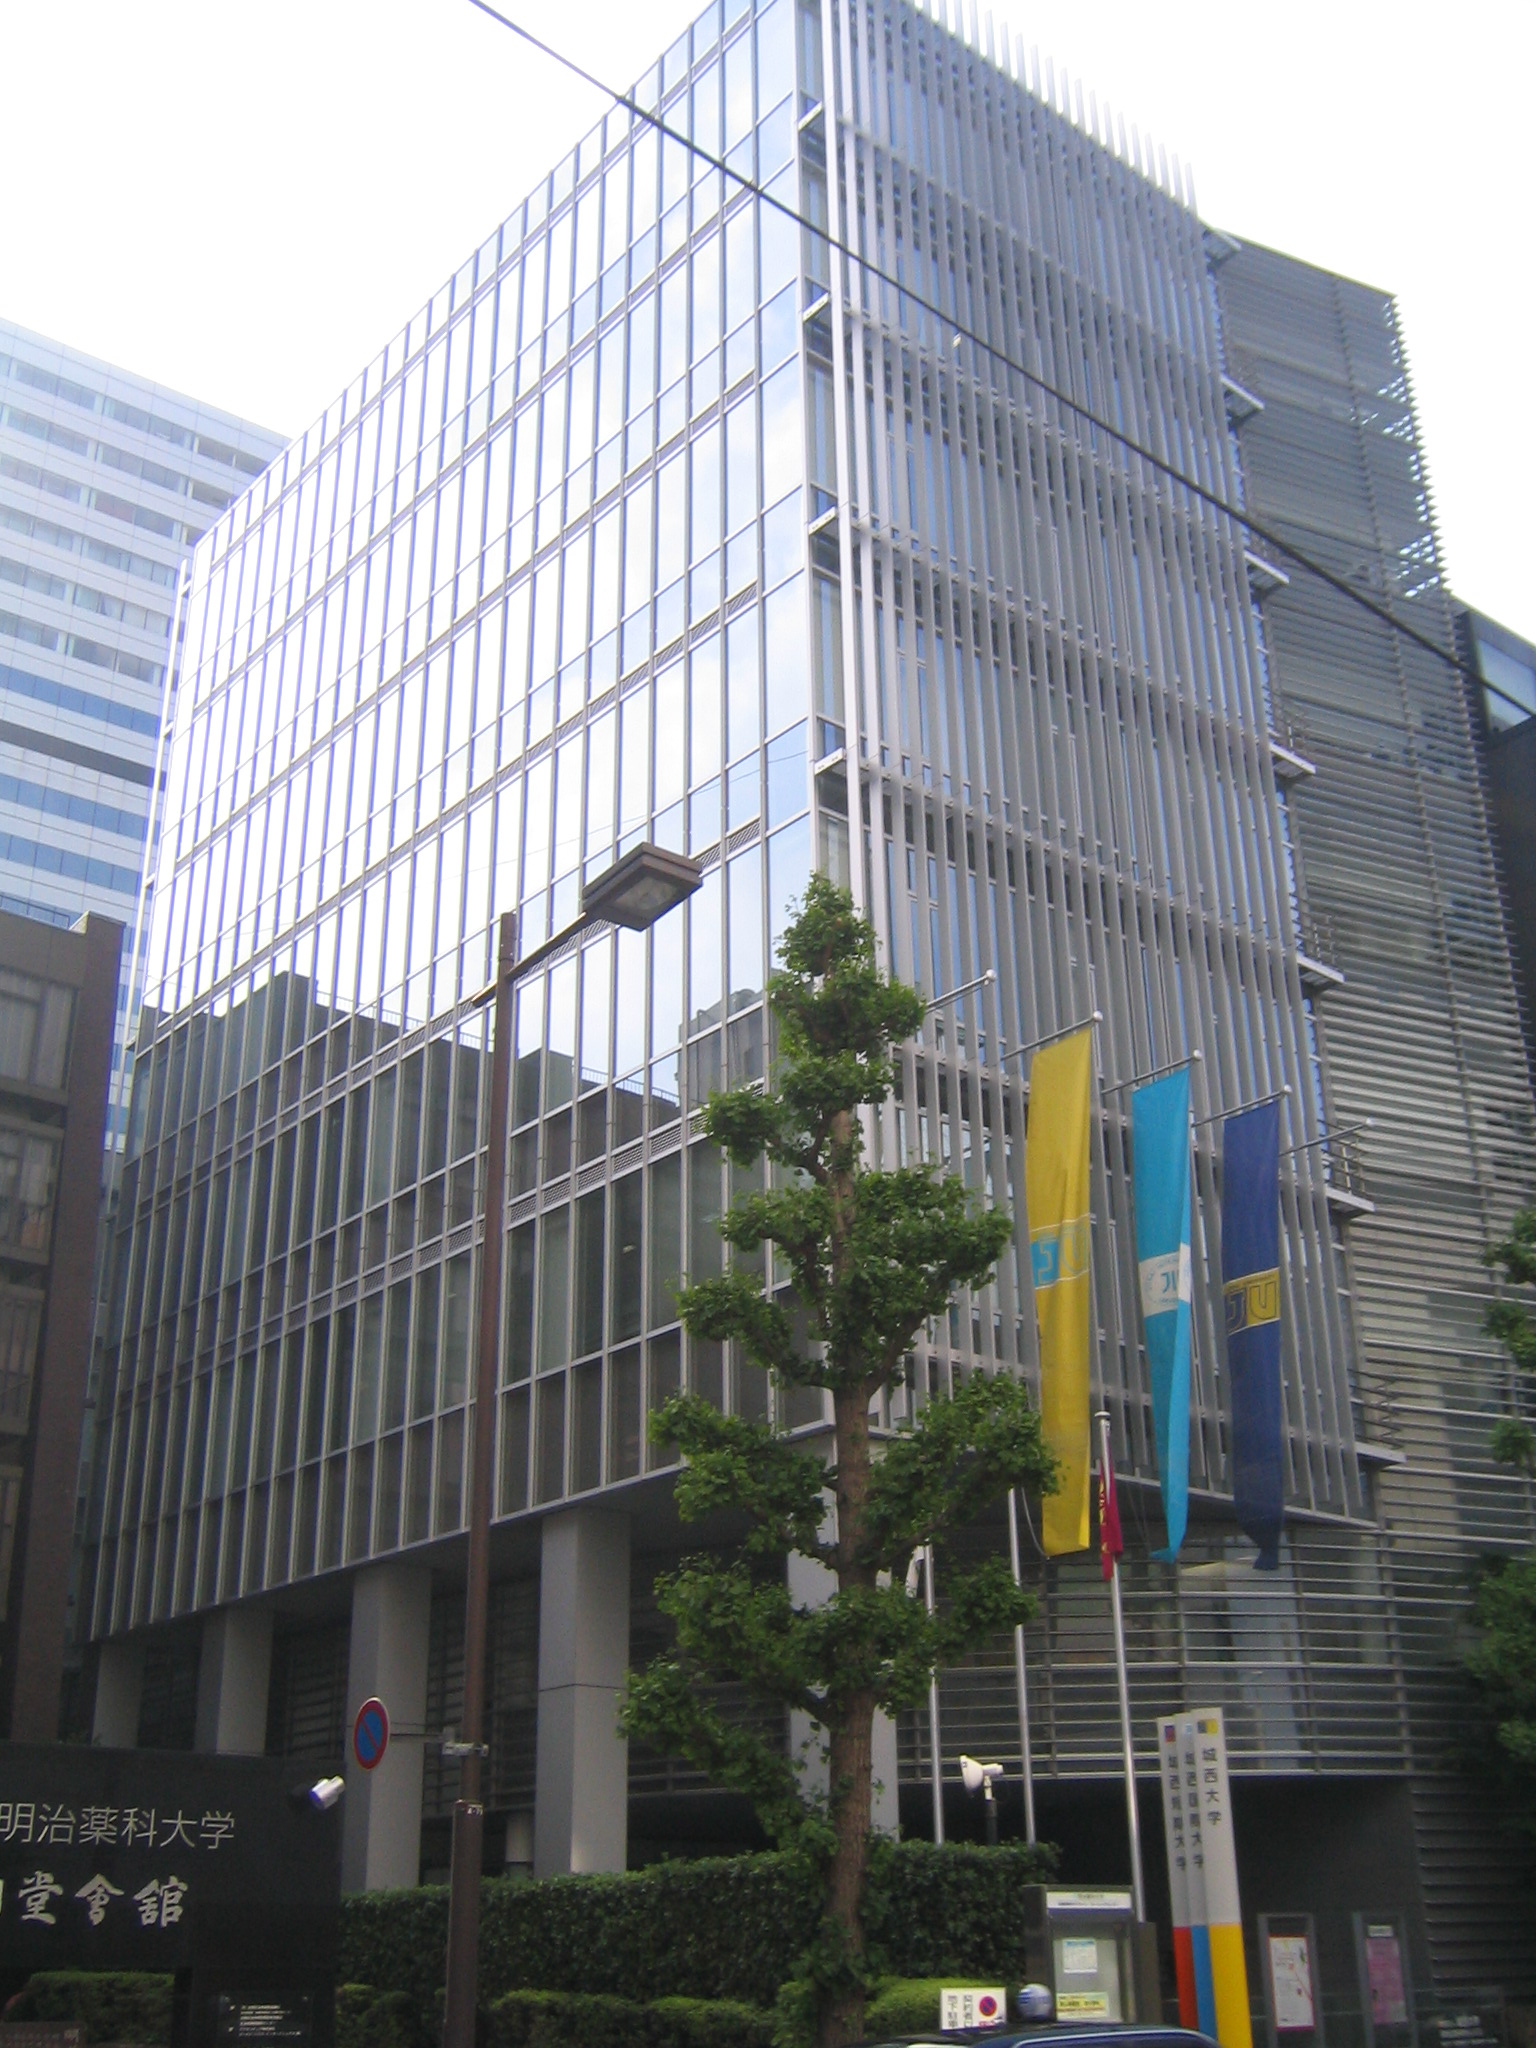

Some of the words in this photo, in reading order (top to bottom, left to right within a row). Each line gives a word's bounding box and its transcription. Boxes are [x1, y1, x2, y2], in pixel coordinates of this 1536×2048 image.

[1226, 1280, 1277, 1332] JU
[0, 1802, 236, 1850] 明治薬科大学
[0, 1870, 189, 1928] 堂會館
